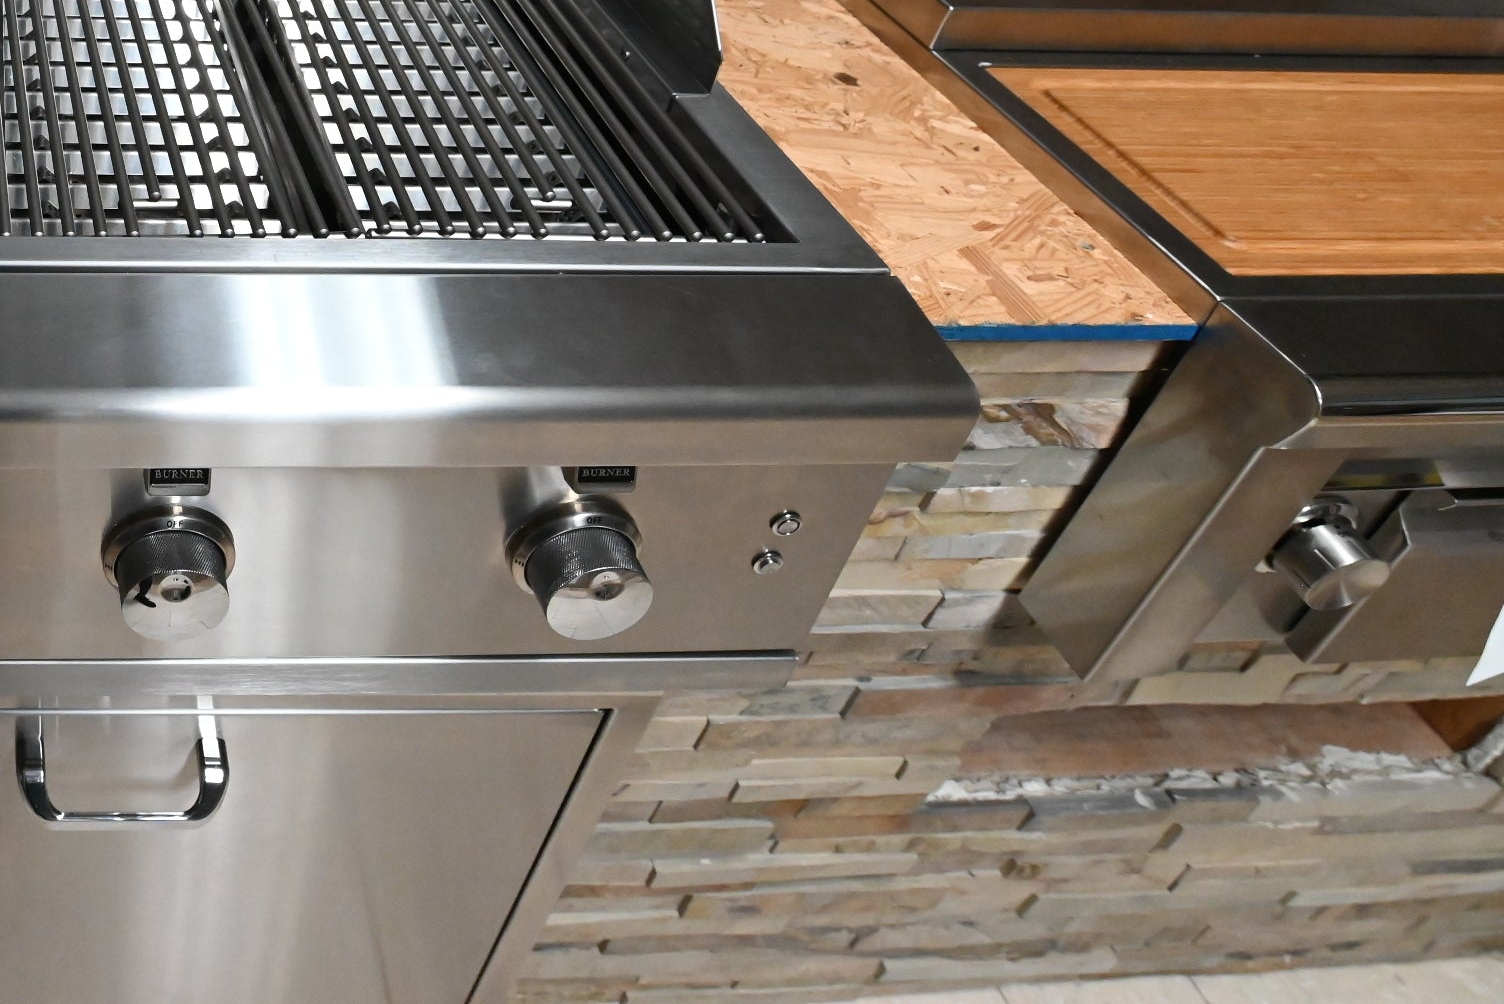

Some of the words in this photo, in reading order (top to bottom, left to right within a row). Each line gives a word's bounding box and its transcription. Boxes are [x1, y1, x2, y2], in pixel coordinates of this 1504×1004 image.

[155, 469, 204, 479] BURNER
[582, 468, 631, 477] BURNER
[166, 520, 184, 529] OFF
[586, 516, 603, 524] OFF
